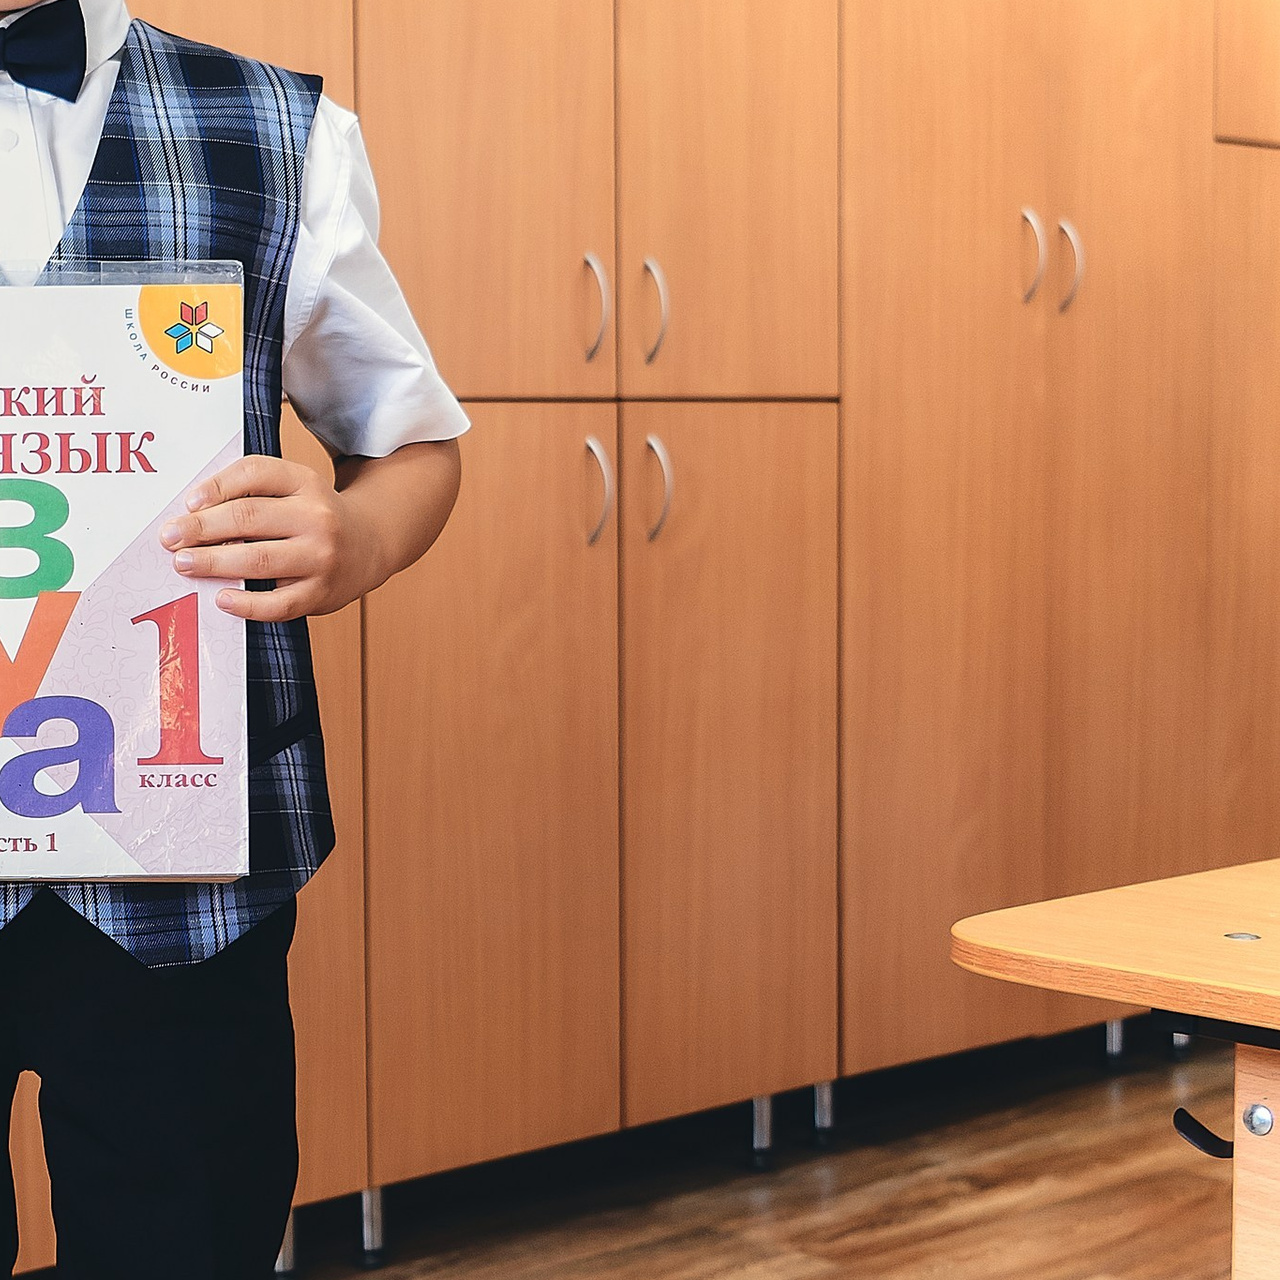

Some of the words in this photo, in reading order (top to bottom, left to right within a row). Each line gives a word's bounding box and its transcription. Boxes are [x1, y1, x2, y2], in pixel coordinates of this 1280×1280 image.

[125, 308, 148, 360] ШКОЛА
[151, 364, 210, 393] РОССИИ
[130, 591, 224, 766] 1
[138, 771, 218, 788] класс
[45, 832, 58, 852] 1
